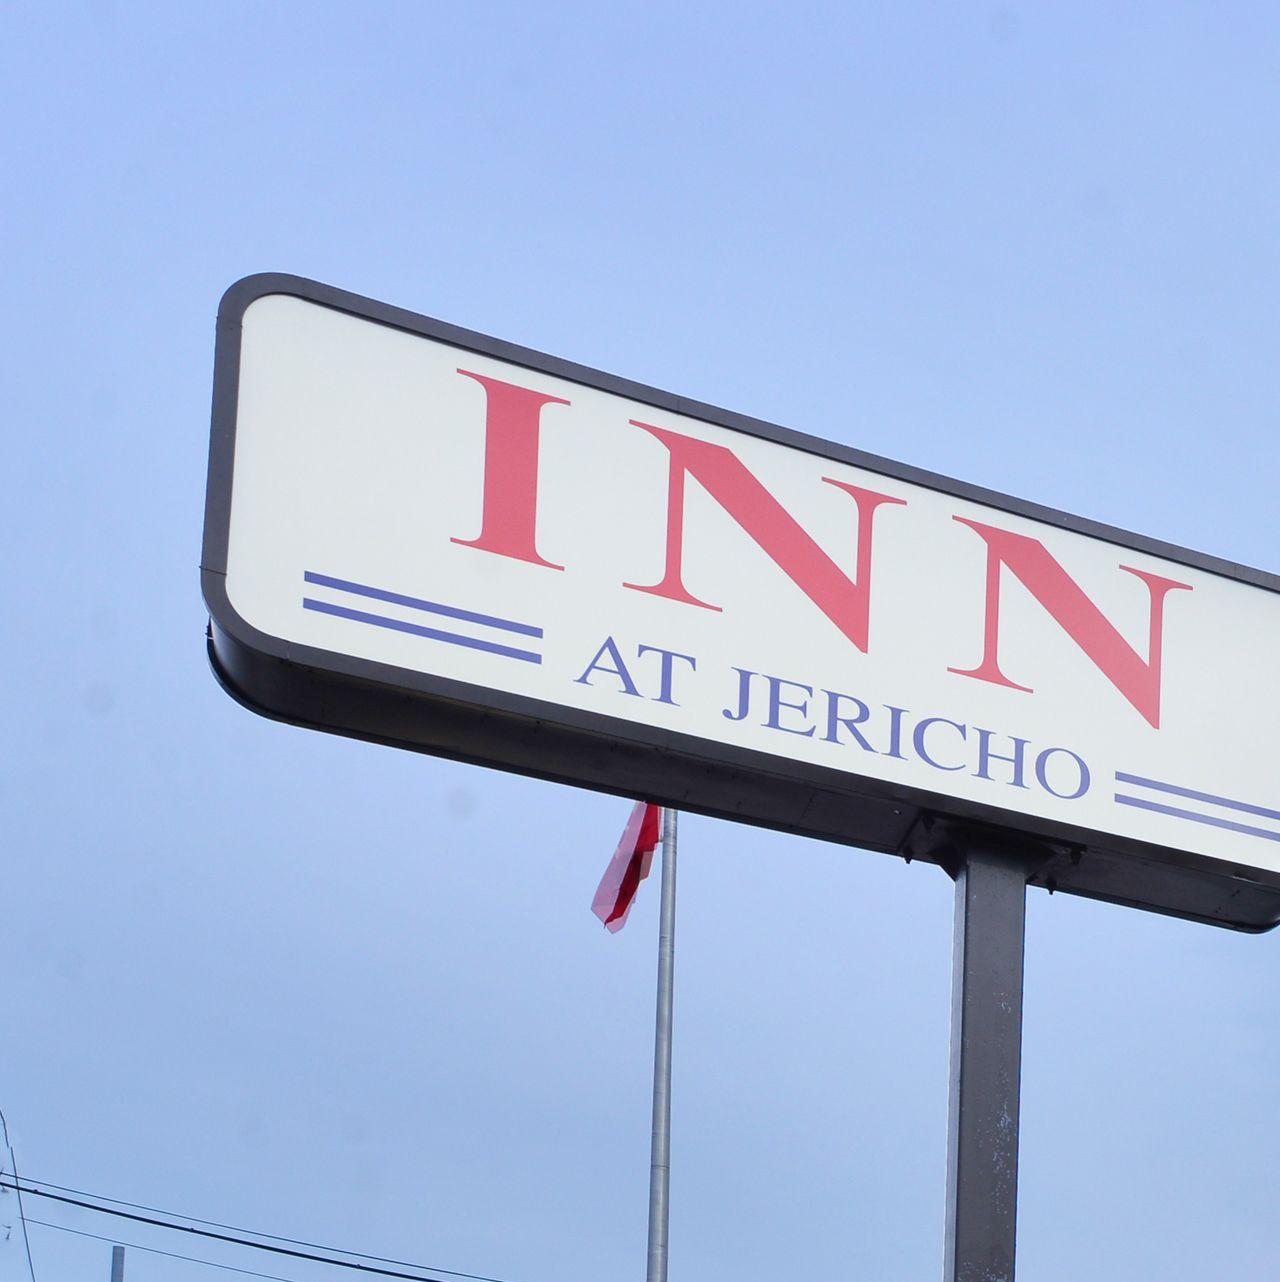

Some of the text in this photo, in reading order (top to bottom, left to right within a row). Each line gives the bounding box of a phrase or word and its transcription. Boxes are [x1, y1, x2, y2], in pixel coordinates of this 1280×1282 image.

[450, 368, 1191, 729] INN
[574, 636, 1093, 800] AT JERICHO
